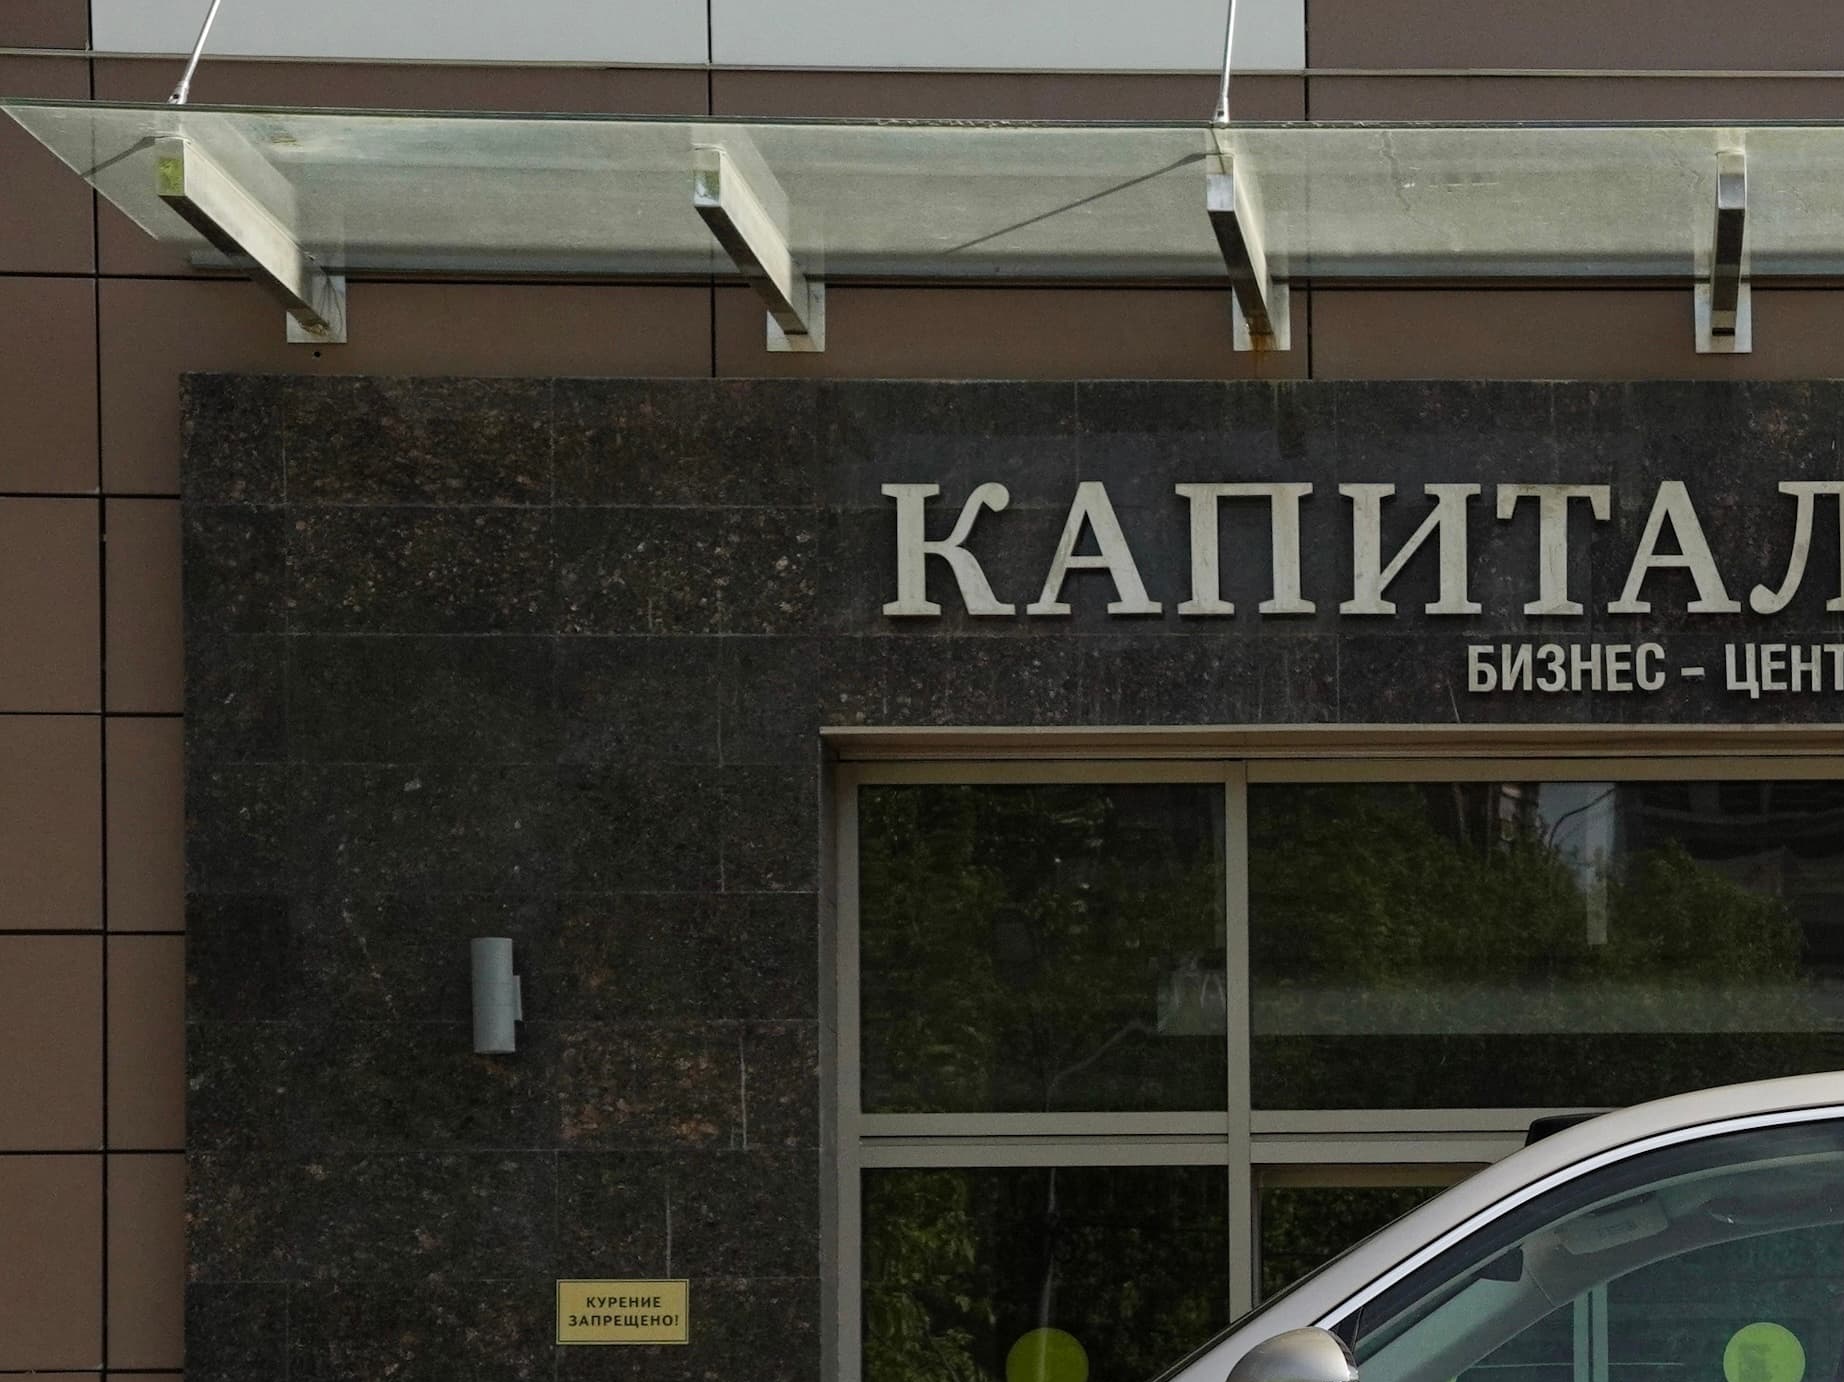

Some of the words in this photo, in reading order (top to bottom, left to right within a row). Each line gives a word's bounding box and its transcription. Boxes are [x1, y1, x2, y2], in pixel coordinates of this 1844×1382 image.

[1467, 642, 1667, 693] БИЗНЕС
[586, 1296, 662, 1308] КУРЕНИЕ
[568, 1314, 679, 1328] ЗАПРЕЩЕНО!
